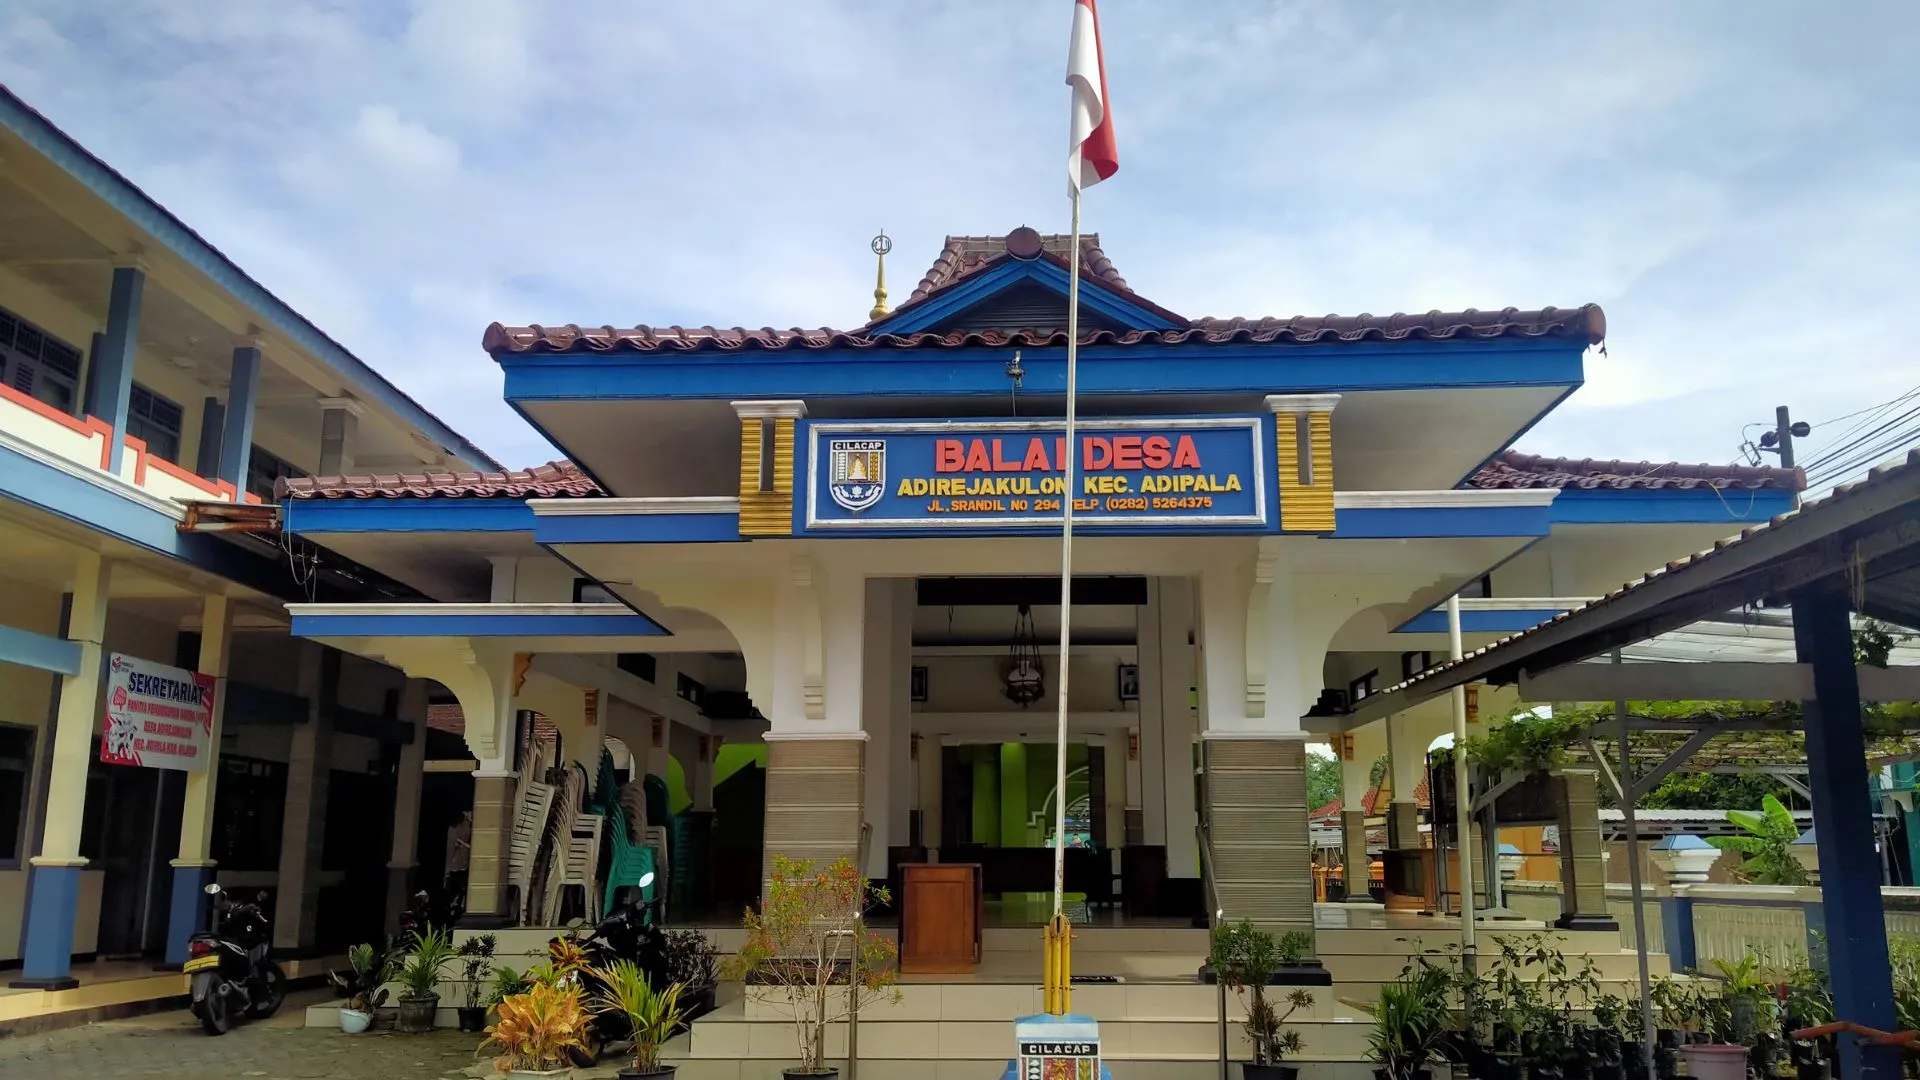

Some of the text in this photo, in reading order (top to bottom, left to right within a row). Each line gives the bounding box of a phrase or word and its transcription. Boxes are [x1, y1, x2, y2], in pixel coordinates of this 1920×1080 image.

[835, 441, 882, 450] CILACAP
[935, 435, 1201, 472] BALAI DESA
[897, 474, 1242, 496] ADIREJAKULON KEC. ADIPALA
[927, 496, 1213, 513] JL. SRANDIL NO 294 ELP. (0282) 5264375
[128, 671, 206, 705] SEKRETARIAT
[1029, 1045, 1091, 1054] CILACAP
